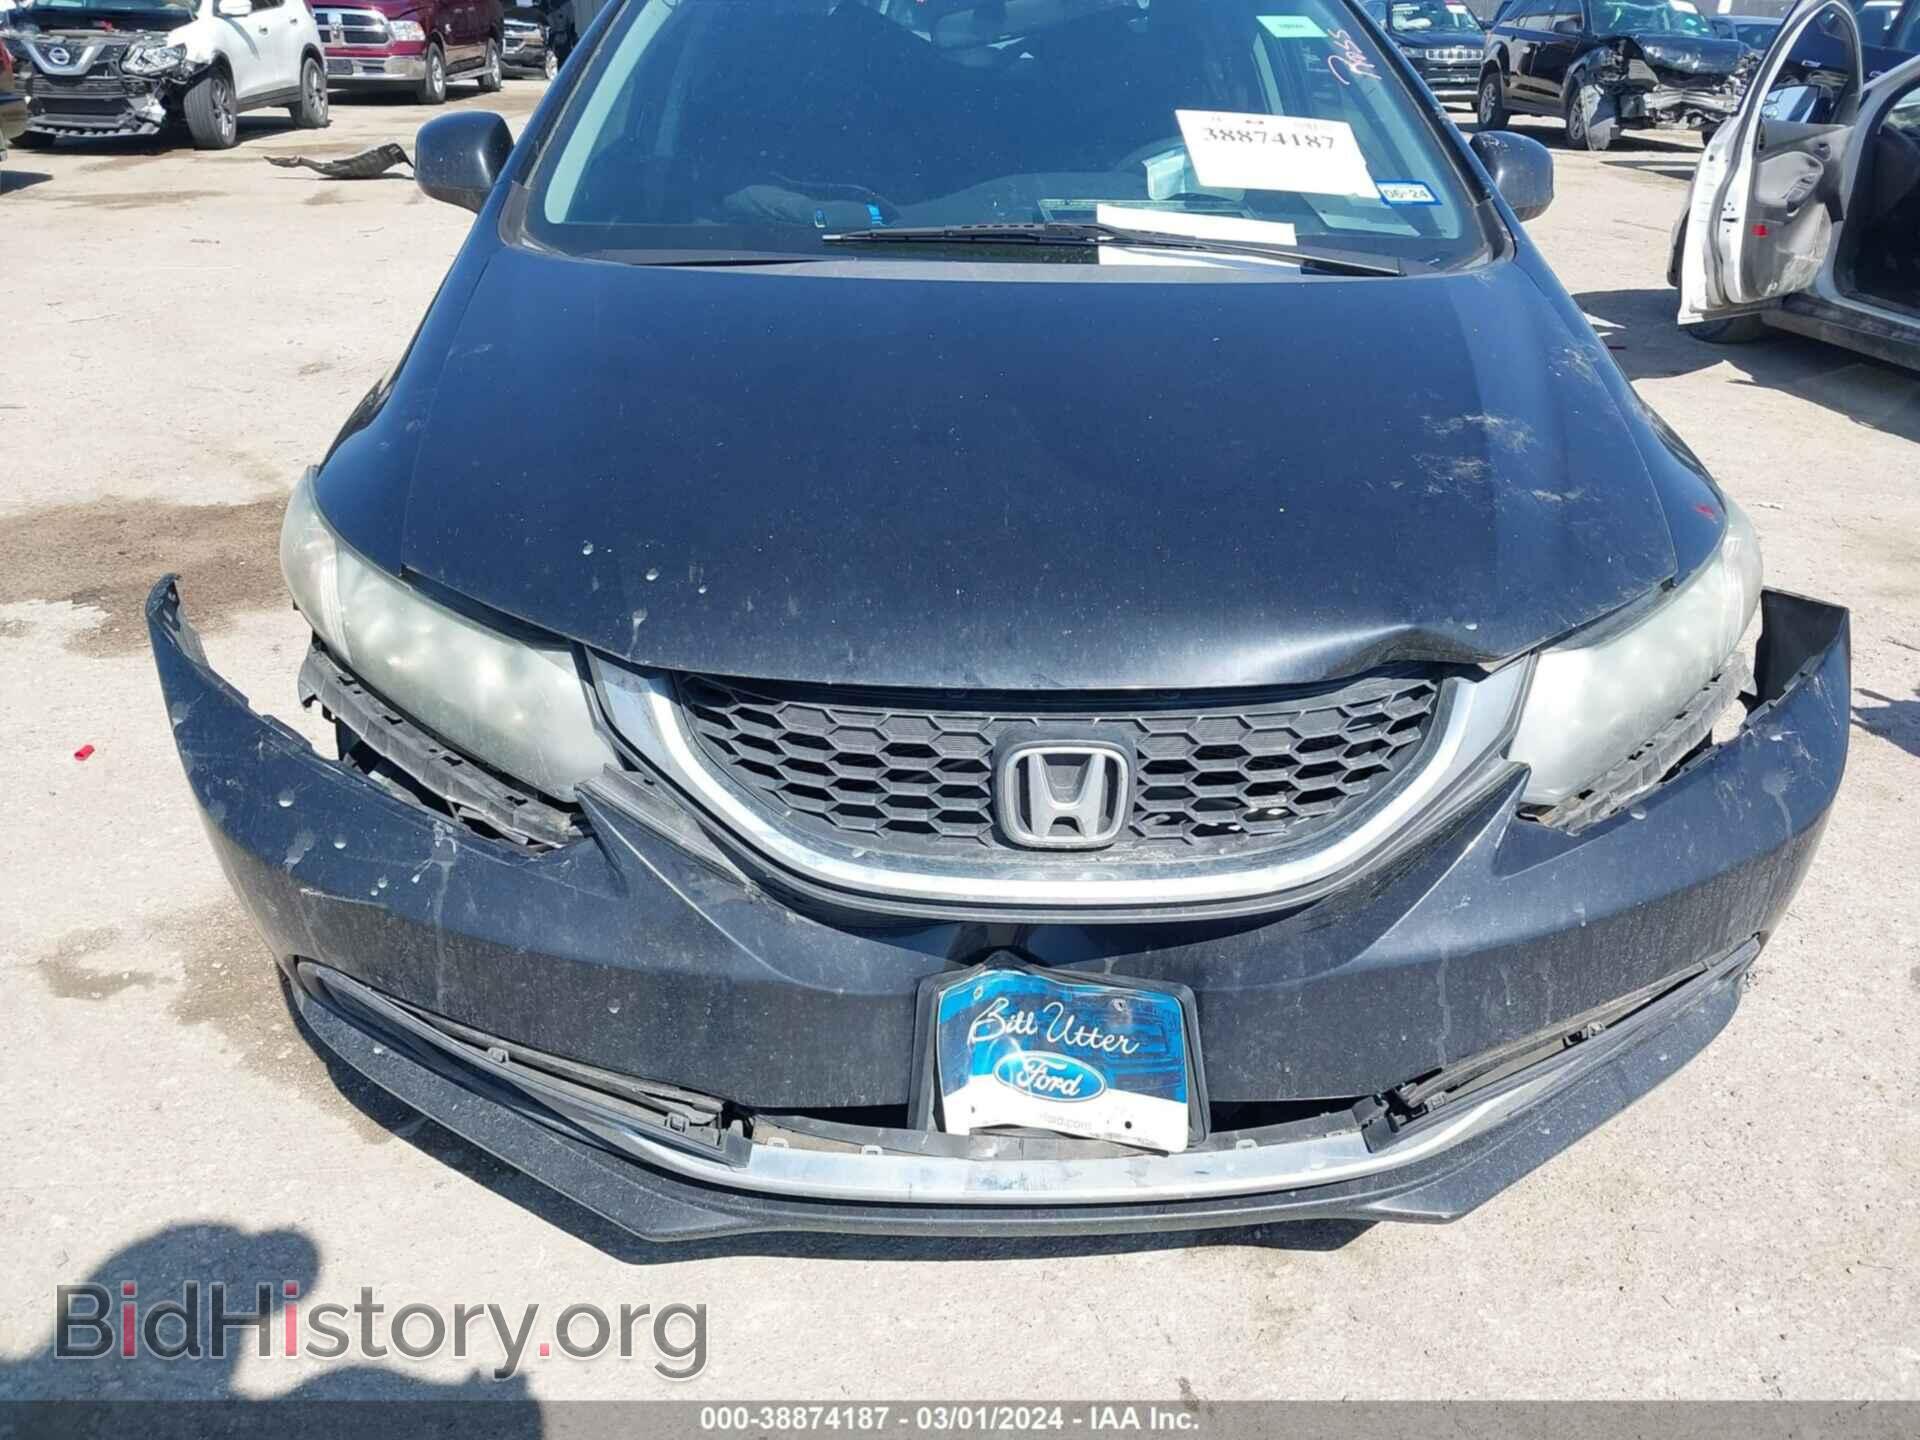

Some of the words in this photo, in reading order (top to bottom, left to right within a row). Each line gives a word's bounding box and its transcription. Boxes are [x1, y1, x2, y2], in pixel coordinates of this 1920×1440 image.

[1203, 127, 1335, 150] 38874187
[967, 998, 1038, 1046] Bill
[1043, 1001, 1140, 1054] Utter
[1017, 1056, 1084, 1097] Ford
